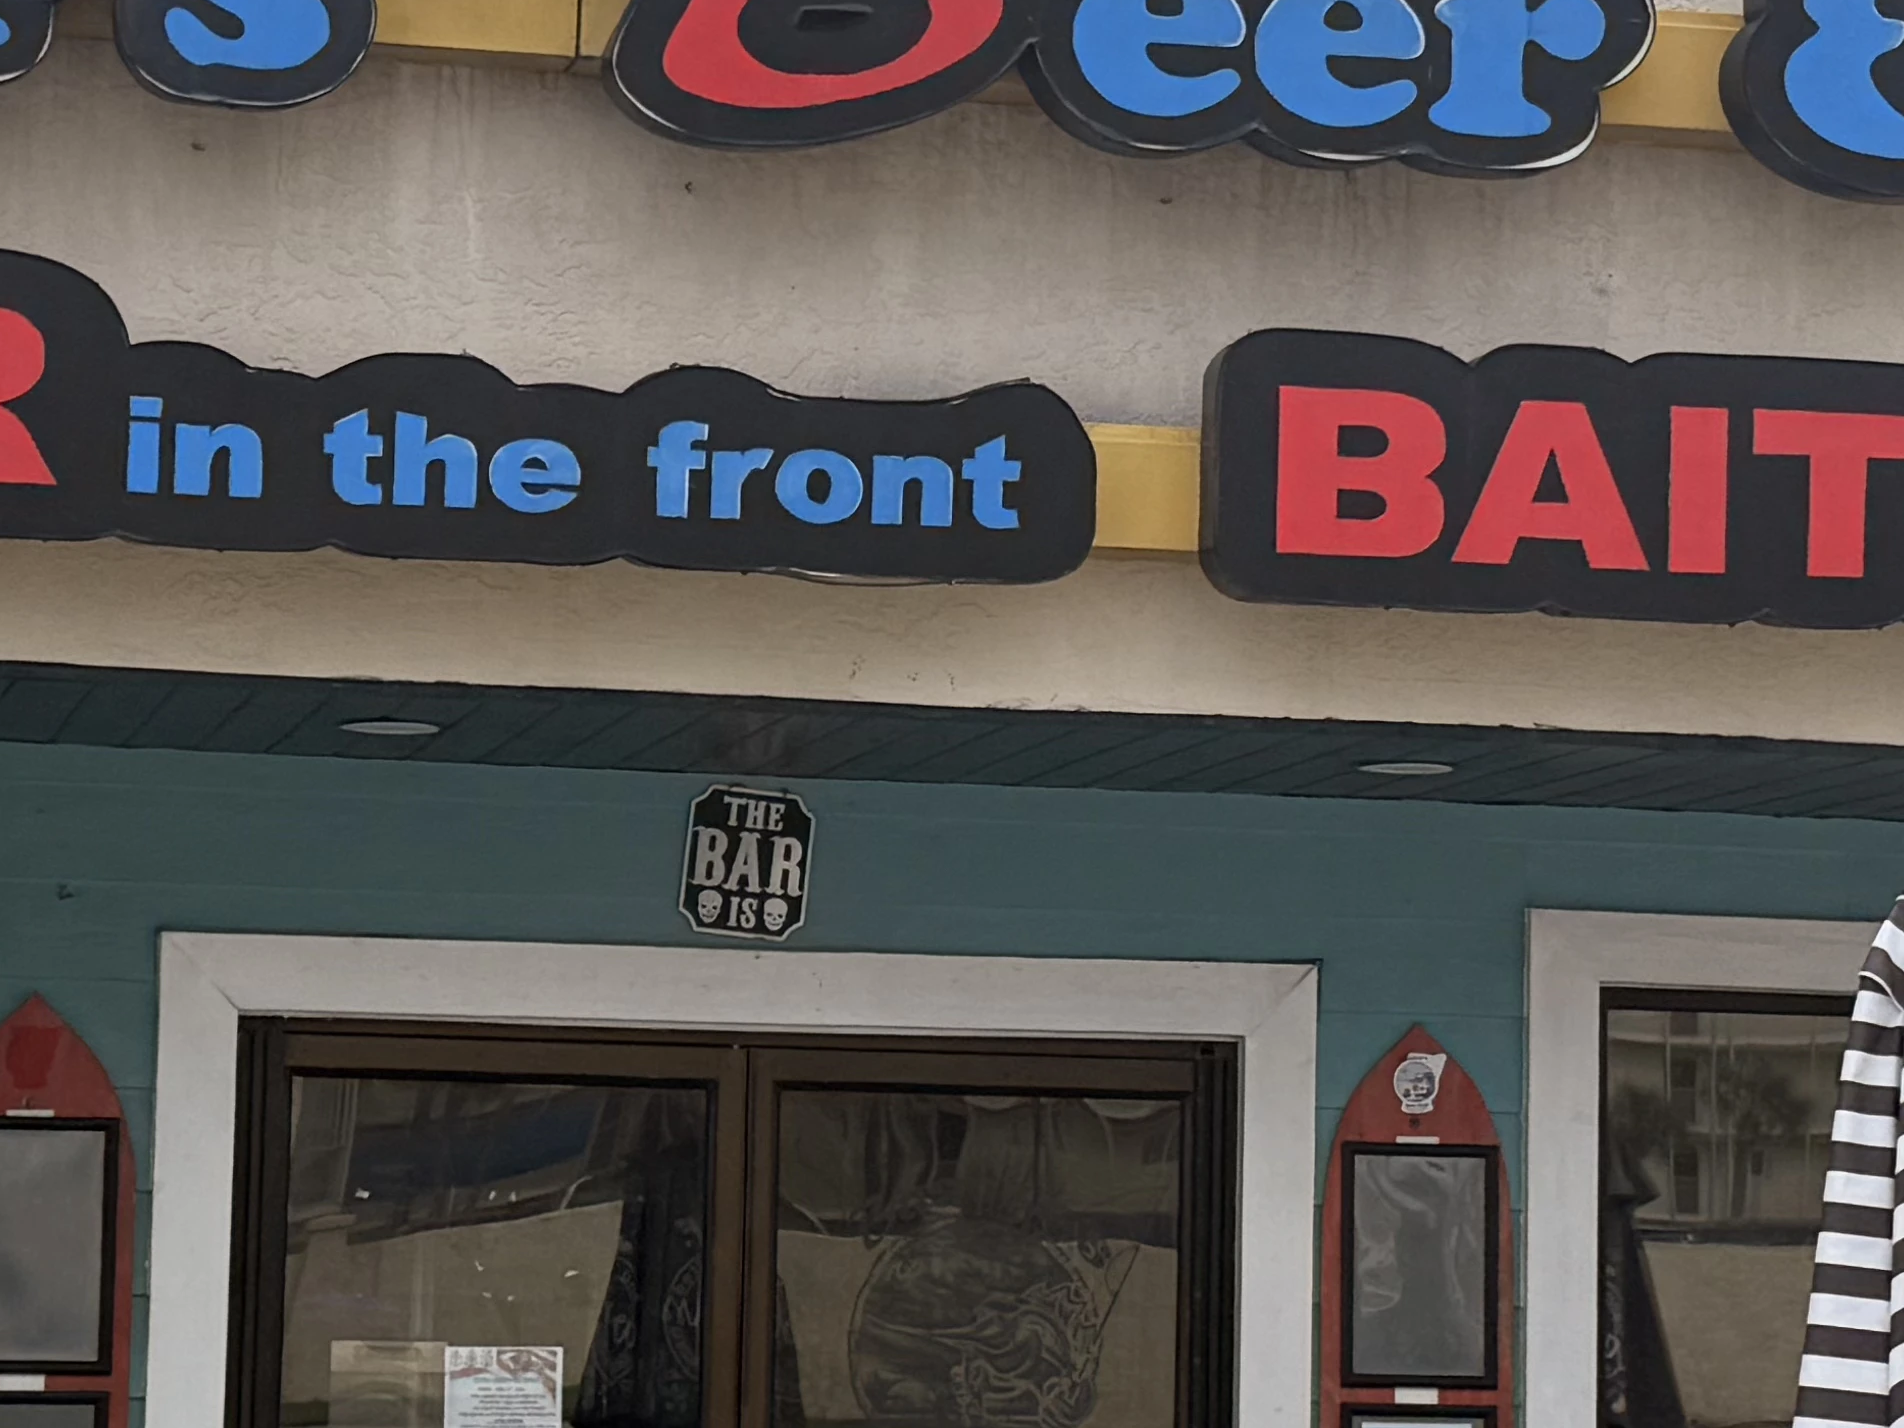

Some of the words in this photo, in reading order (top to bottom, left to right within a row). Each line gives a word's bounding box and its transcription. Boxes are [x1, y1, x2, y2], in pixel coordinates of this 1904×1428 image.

[125, 396, 264, 499] in
[323, 409, 582, 515] the
[646, 420, 1023, 530] front
[723, 795, 786, 831] THE
[688, 825, 802, 897] BAR
[727, 896, 758, 929] IS
